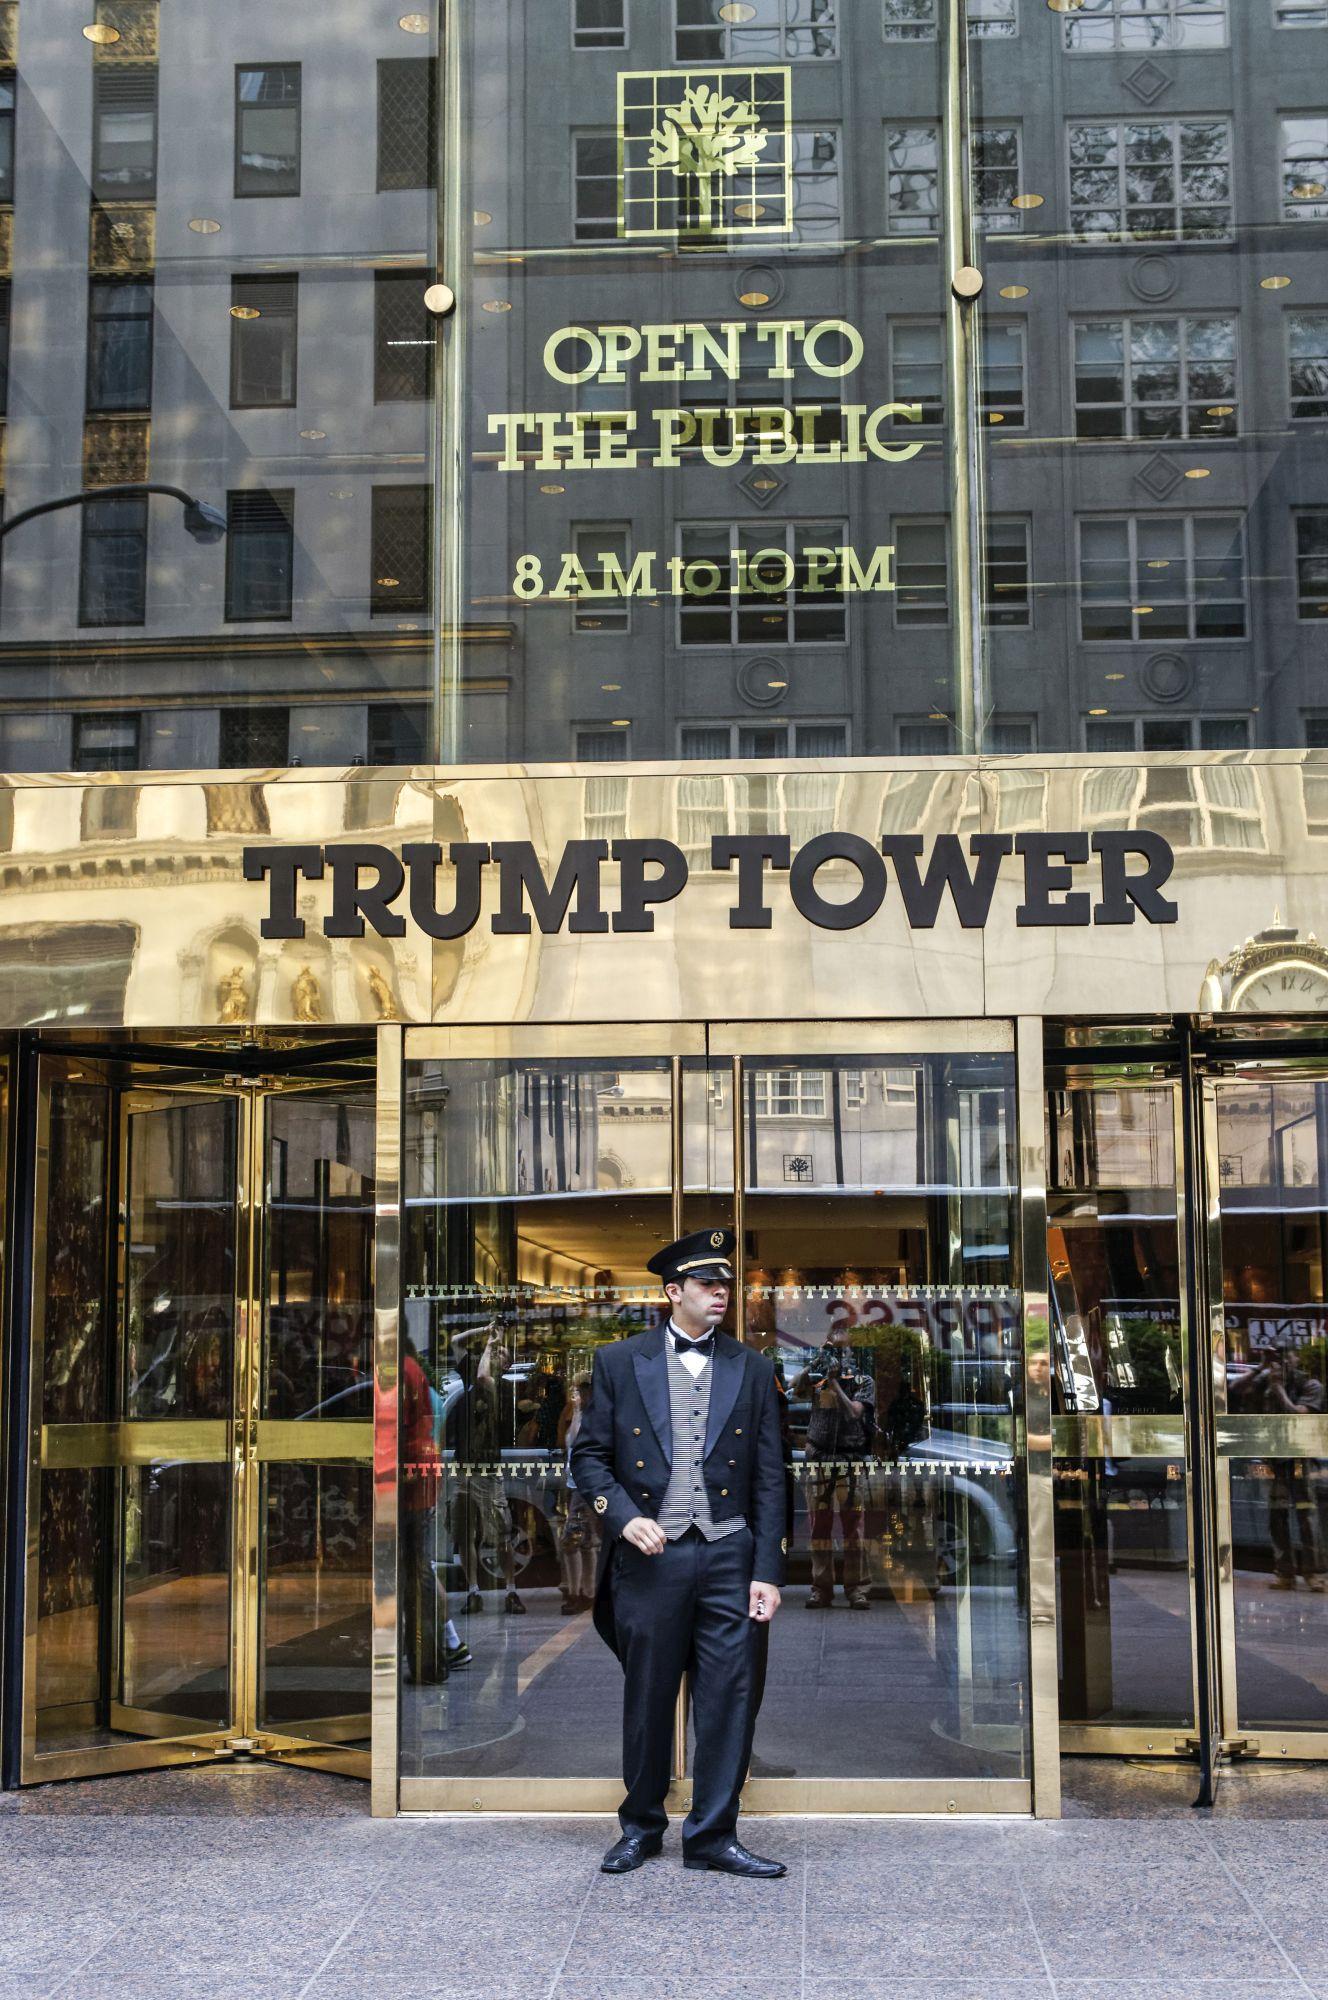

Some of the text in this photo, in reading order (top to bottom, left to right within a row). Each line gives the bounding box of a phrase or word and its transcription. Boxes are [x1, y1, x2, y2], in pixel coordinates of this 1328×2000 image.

[543, 320, 864, 385] OPEN TO
[487, 402, 924, 472] THE PUBLIC
[666, 556, 721, 597] to
[730, 548, 795, 594] 10
[802, 545, 896, 592] PM
[242, 829, 1179, 940] TRUMP TOWER
